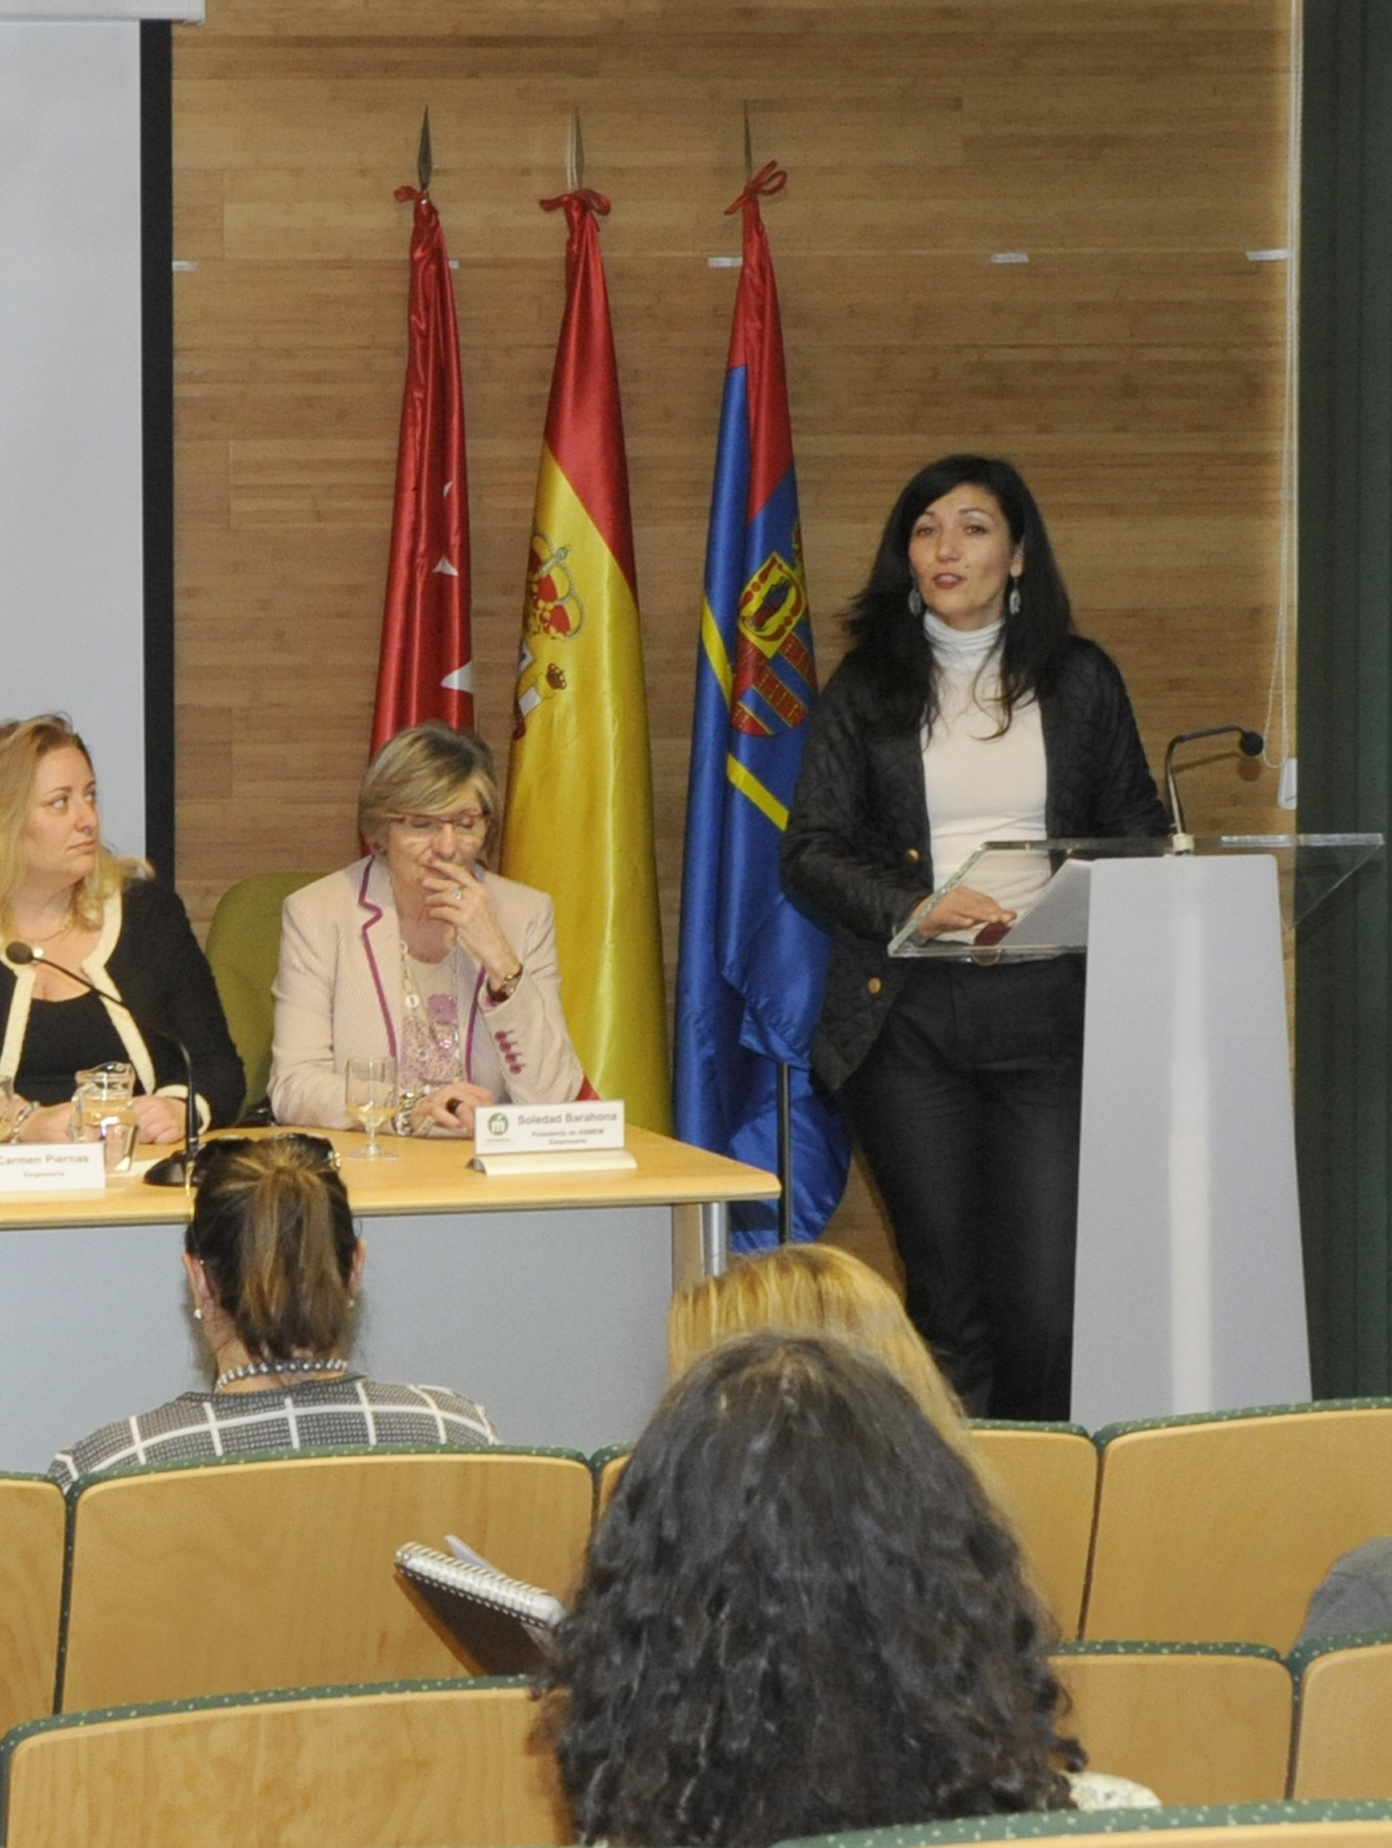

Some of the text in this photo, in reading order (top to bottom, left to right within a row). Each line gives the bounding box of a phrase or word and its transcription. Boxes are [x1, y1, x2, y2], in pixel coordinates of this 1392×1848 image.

[518, 1112, 616, 1125] Soledad Barahona
[46, 1154, 89, 1164] Piernas
